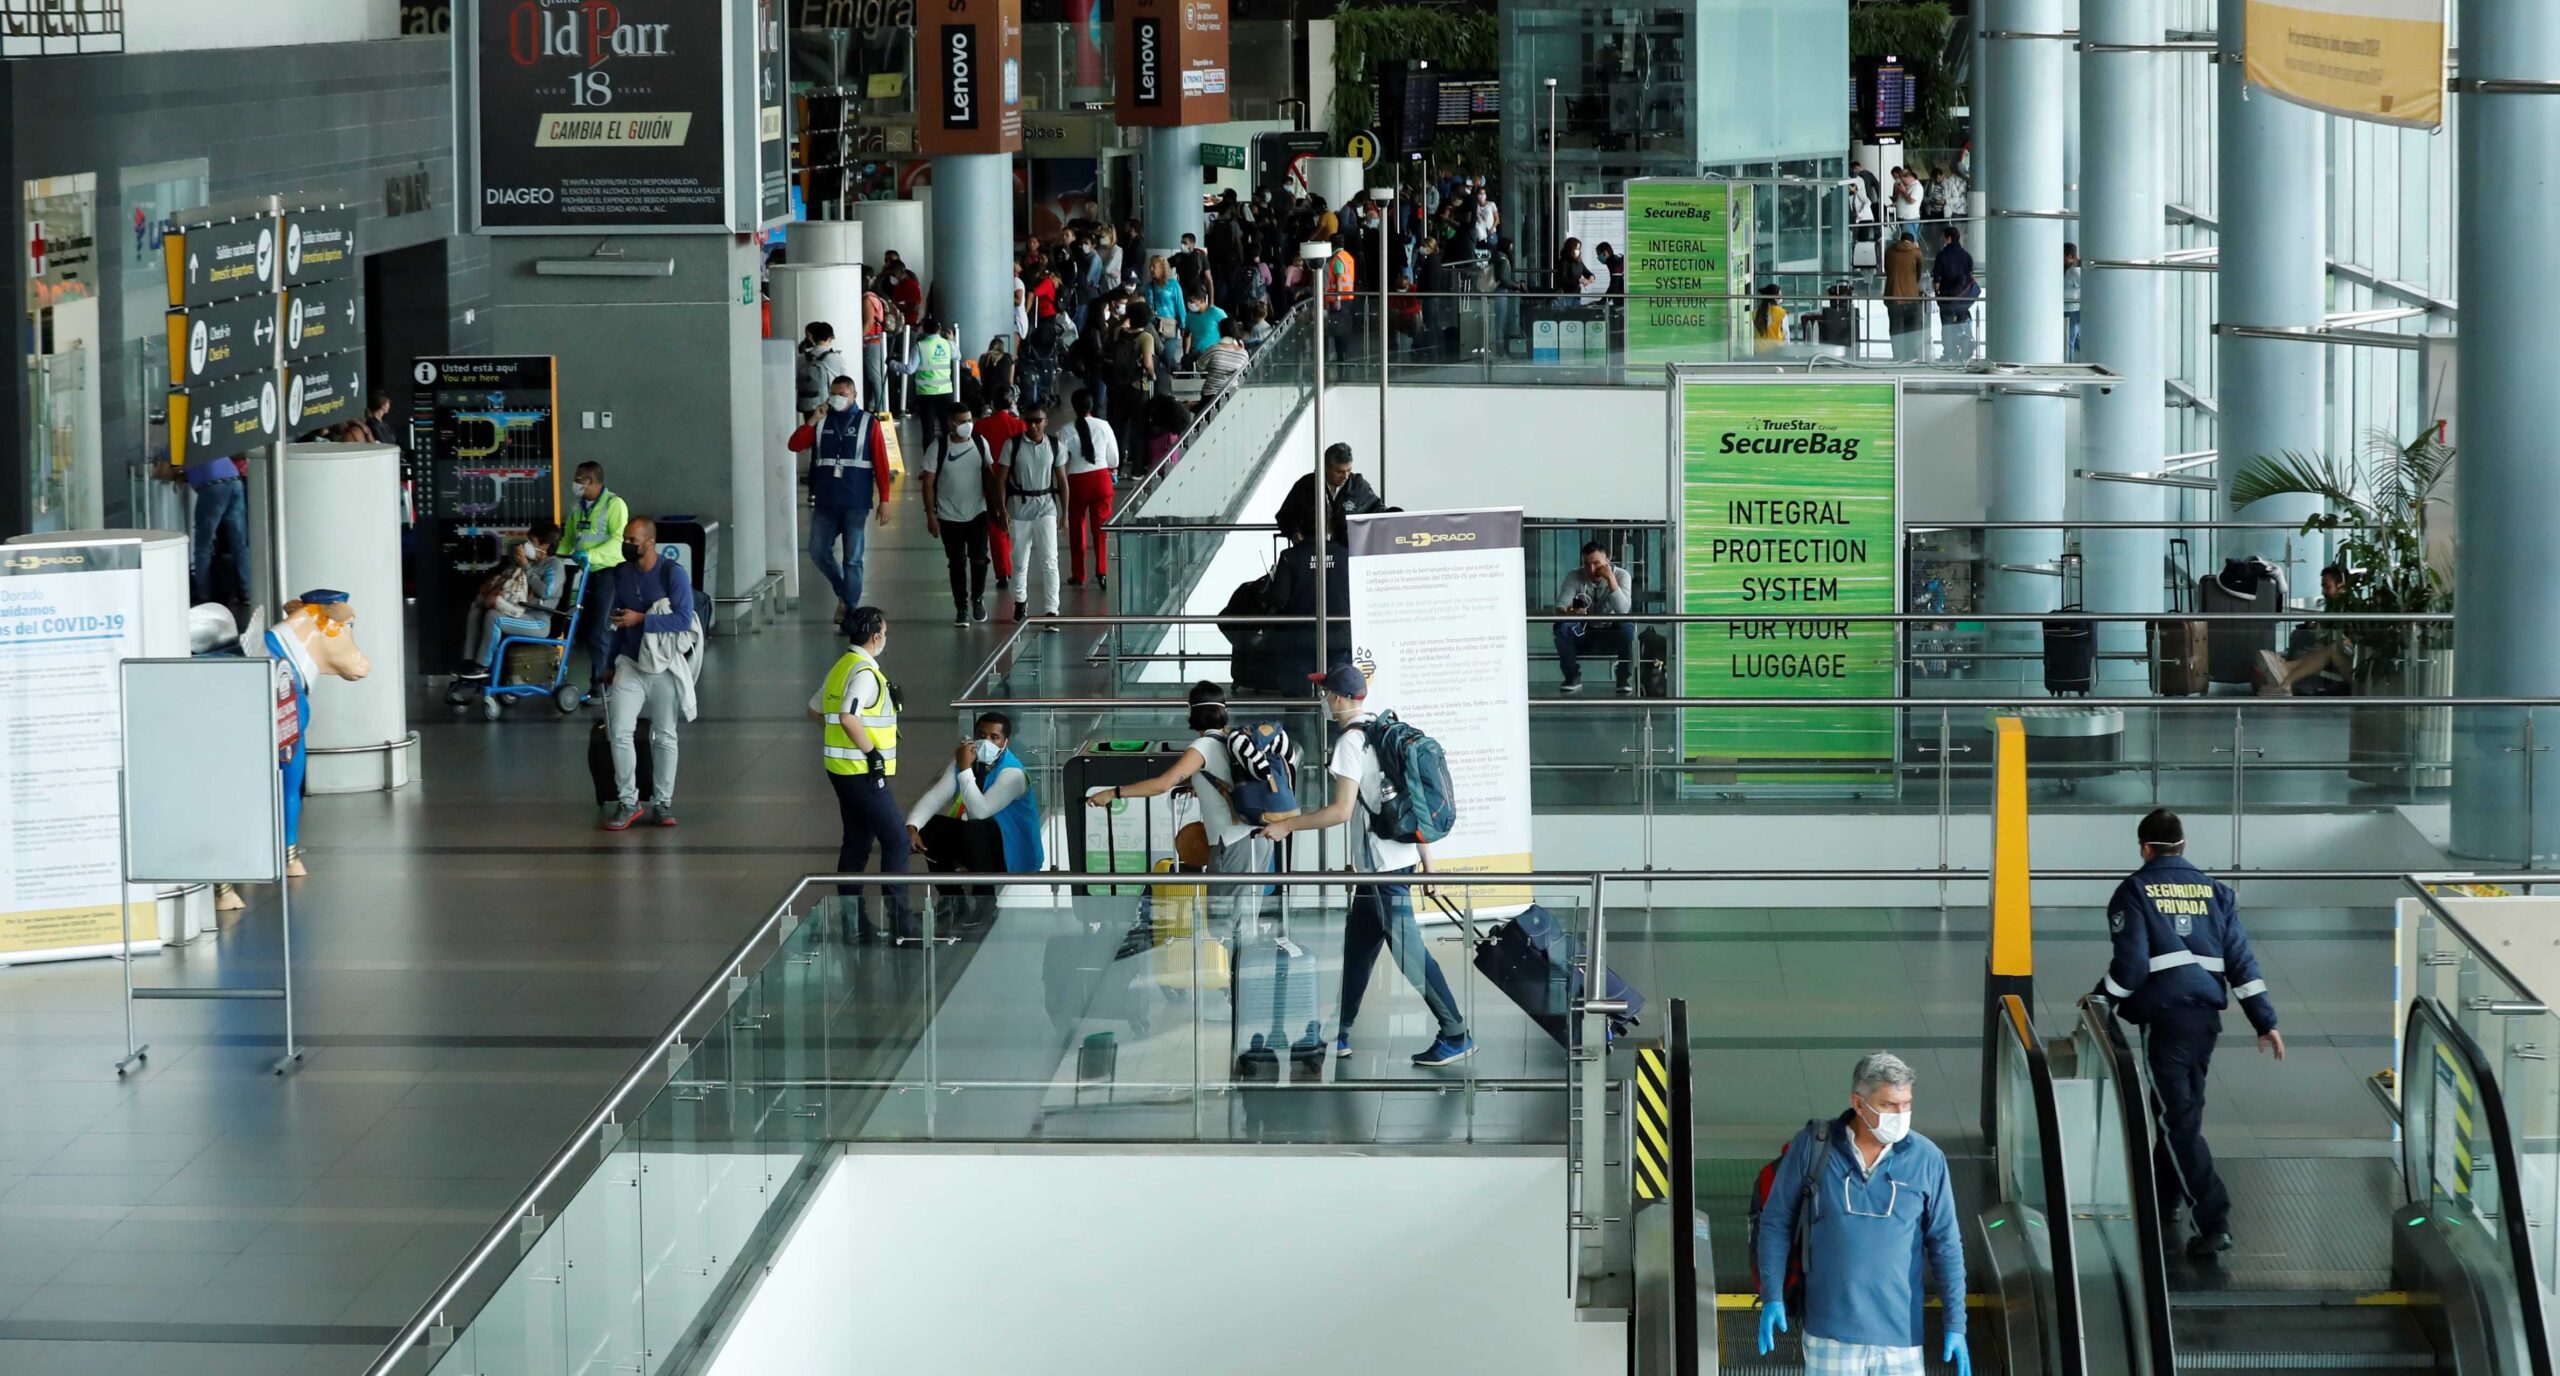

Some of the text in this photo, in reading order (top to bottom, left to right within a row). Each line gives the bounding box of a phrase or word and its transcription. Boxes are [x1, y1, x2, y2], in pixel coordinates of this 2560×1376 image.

[510, 0, 671, 69] Old Parr
[1140, 25, 1154, 99] Lenovo
[951, 33, 970, 122] Lenovo
[568, 72, 612, 106] 18
[550, 116, 673, 140] CAMBIA EL GUIÓN
[487, 188, 554, 204] DIAGEO
[1644, 207, 1711, 221] SecureBag
[1649, 240, 1706, 252] INTEGRAL
[1642, 259, 1714, 271] PROTECTION
[1656, 277, 1701, 290] SYSTEM
[1650, 298, 1706, 308] FOR YOUR
[1652, 314, 1705, 326] LUGGAGE
[442, 362, 518, 374] Usted está aquí
[443, 374, 459, 382] You
[1763, 420, 1817, 430] TrueStar
[1720, 432, 1860, 460] SecureBag
[1729, 501, 1850, 524] INTEGRAL
[1396, 536, 1412, 545] EL
[1714, 539, 1866, 562] PROTECTION
[1, 589, 44, 602] Dorado
[1742, 578, 1837, 602] SYSTEM
[16, 614, 124, 634] del COVID-19
[1729, 622, 1848, 640] FOR YOUR
[1732, 654, 1846, 678] LUGGAGE
[2145, 884, 2213, 898] SEGURIDAD
[2156, 899, 2208, 915] PRIVADA
